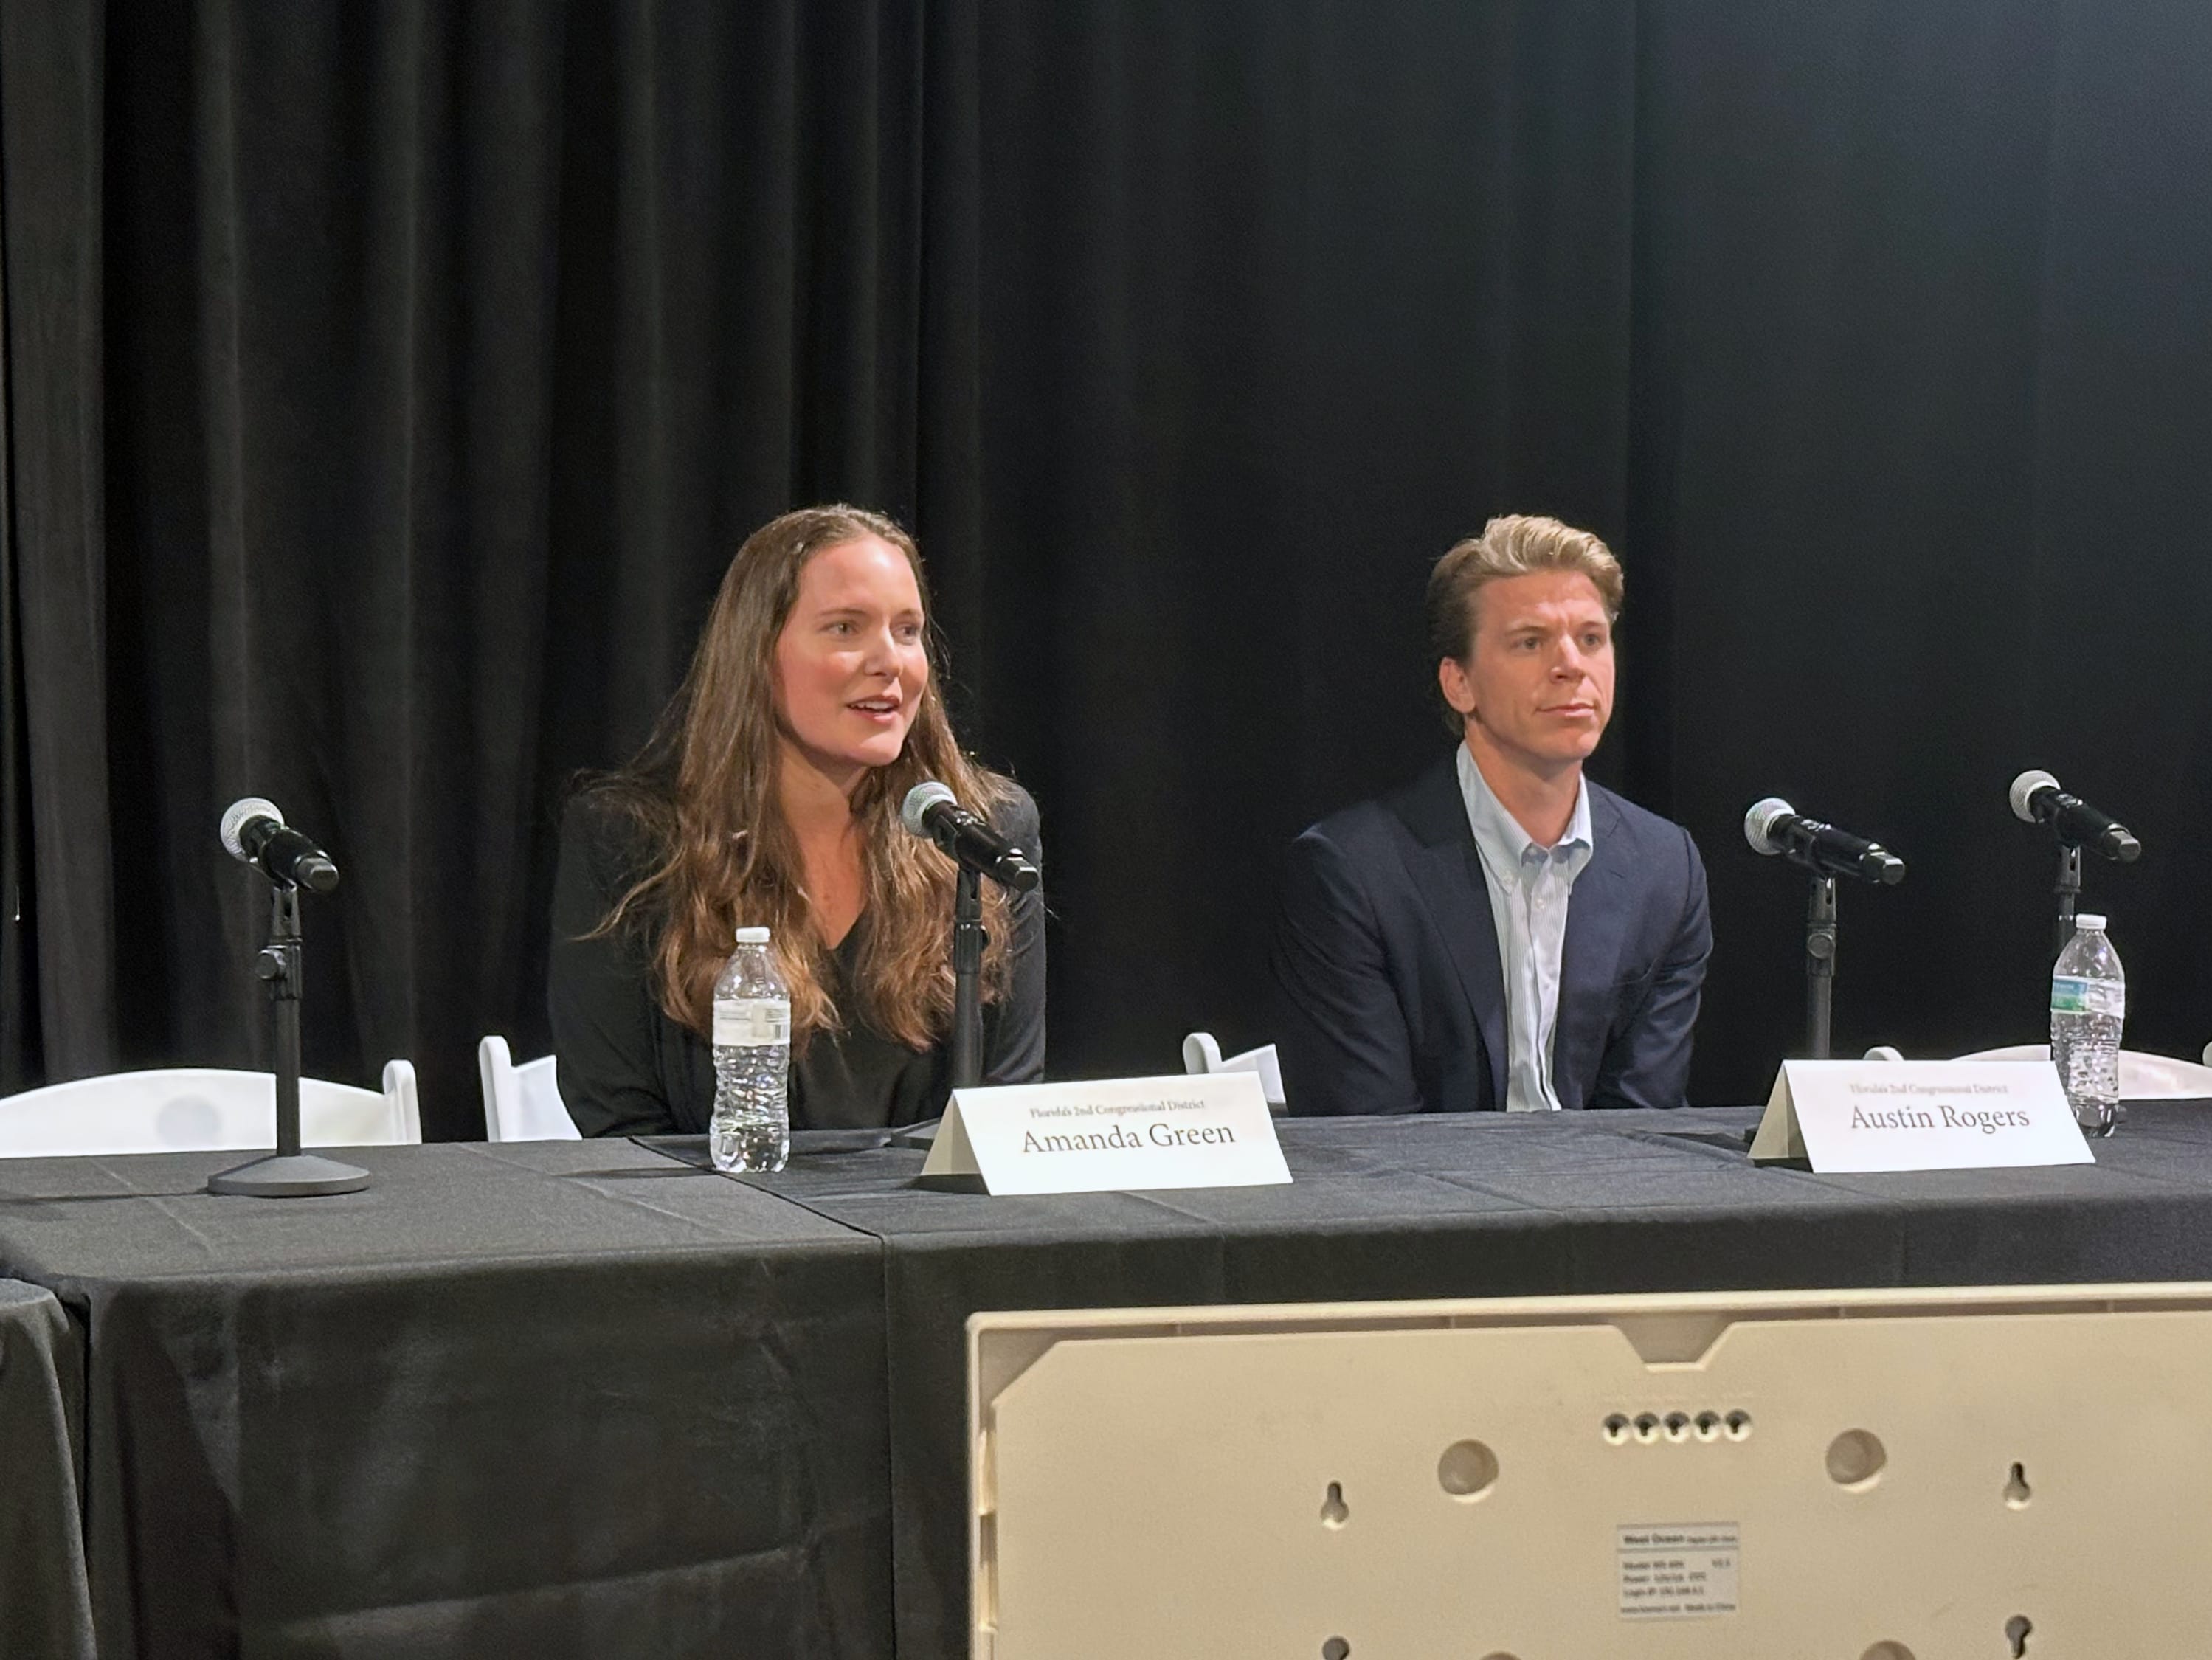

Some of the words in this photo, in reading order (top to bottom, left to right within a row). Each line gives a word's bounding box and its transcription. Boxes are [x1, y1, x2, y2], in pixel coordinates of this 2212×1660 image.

[1074, 1105, 1093, 1116] 2nd
[1168, 1099, 1206, 1110] District
[1851, 1105, 1935, 1129] Austin
[1939, 1105, 2030, 1134] Rogers
[1023, 1125, 1143, 1152] Amanda
[1149, 1123, 1236, 1147] Green
